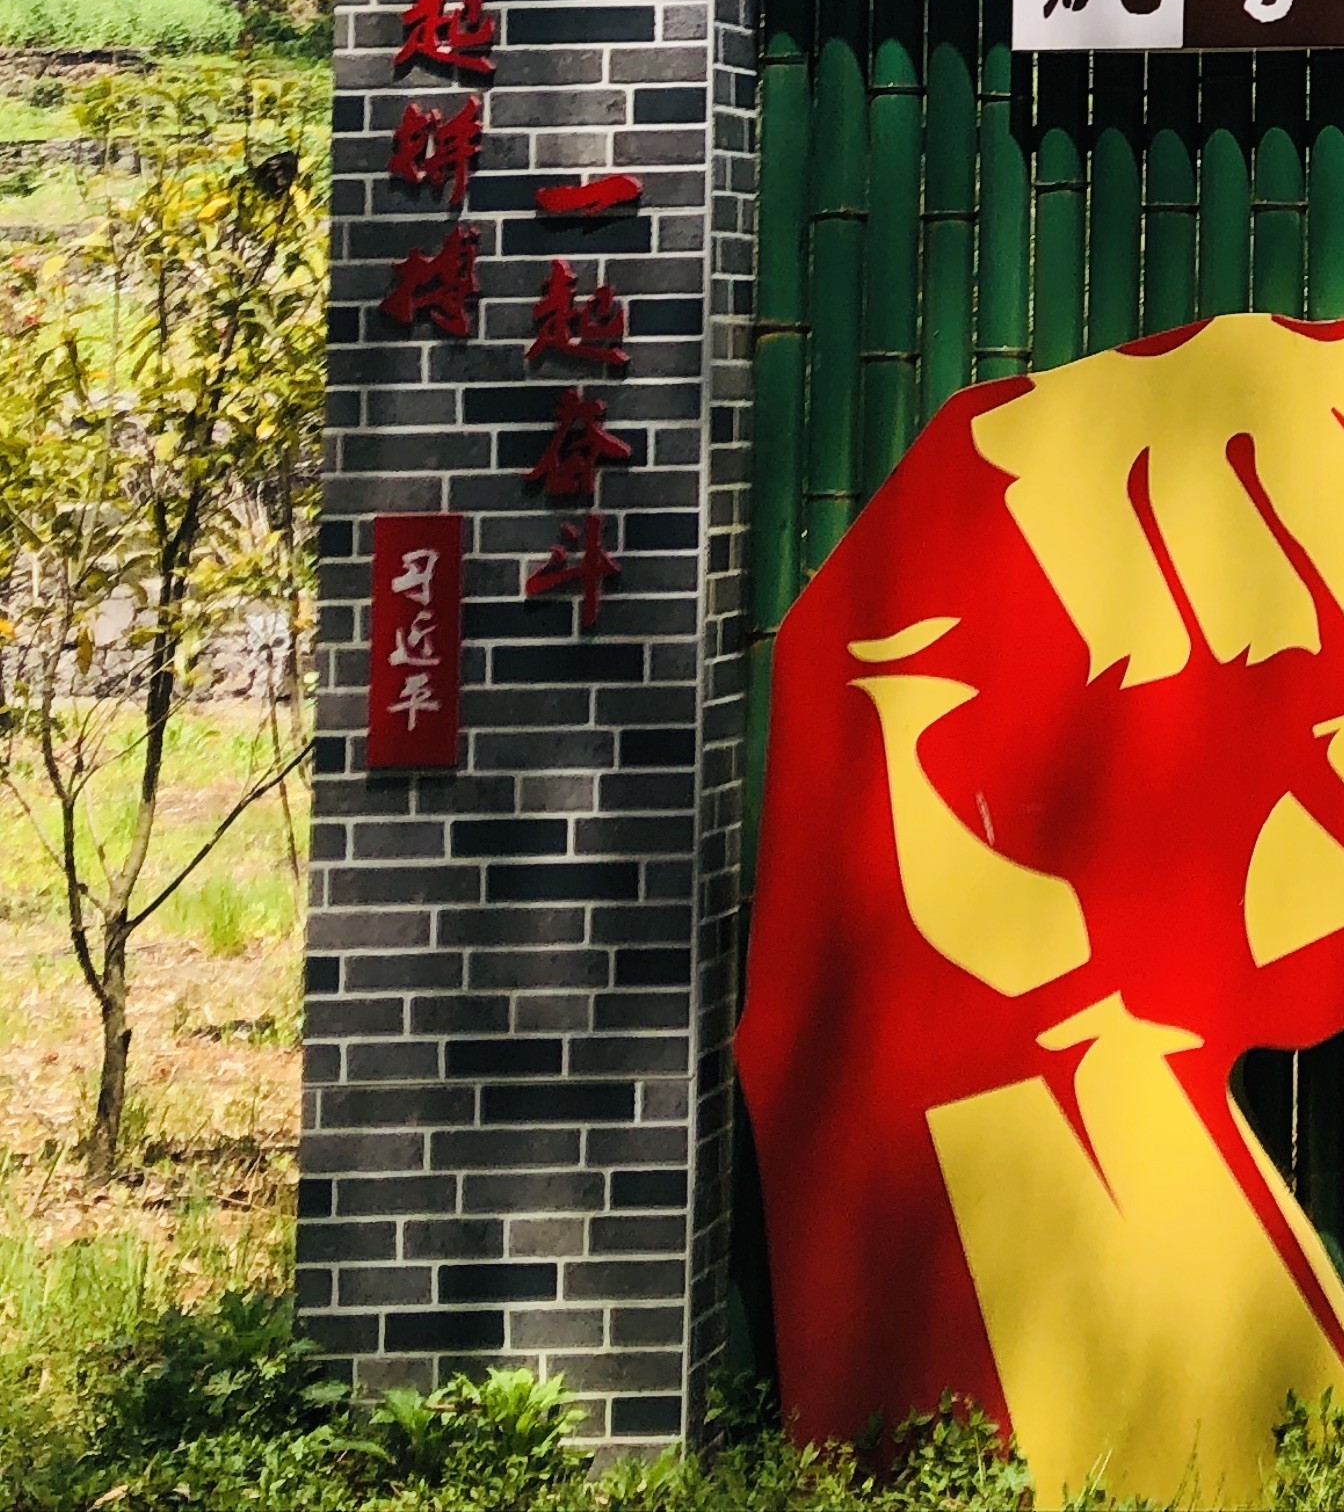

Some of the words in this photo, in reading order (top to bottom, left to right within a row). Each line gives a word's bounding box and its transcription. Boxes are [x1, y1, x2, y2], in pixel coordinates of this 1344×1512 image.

[525, 174, 643, 628] 一起奋斗
[386, 546, 441, 732] 习近平
